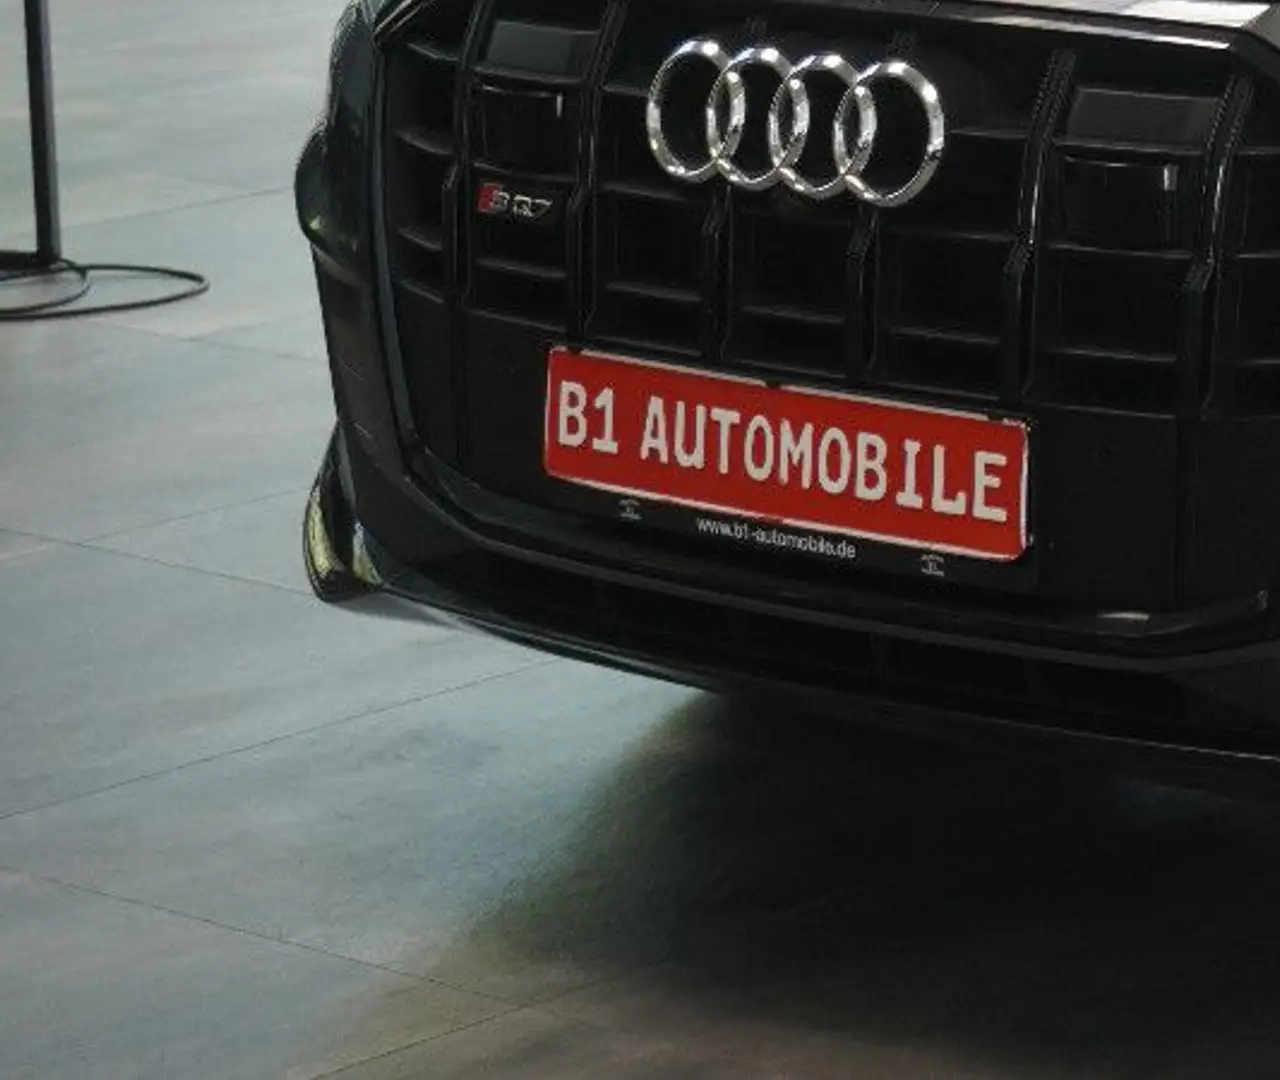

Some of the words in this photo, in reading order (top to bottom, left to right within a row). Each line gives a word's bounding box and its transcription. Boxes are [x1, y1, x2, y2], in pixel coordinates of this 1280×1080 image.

[558, 381, 618, 454] B1
[641, 395, 1007, 522] AUTOMOBILE
[697, 518, 856, 560] www.b1-automobile.de
